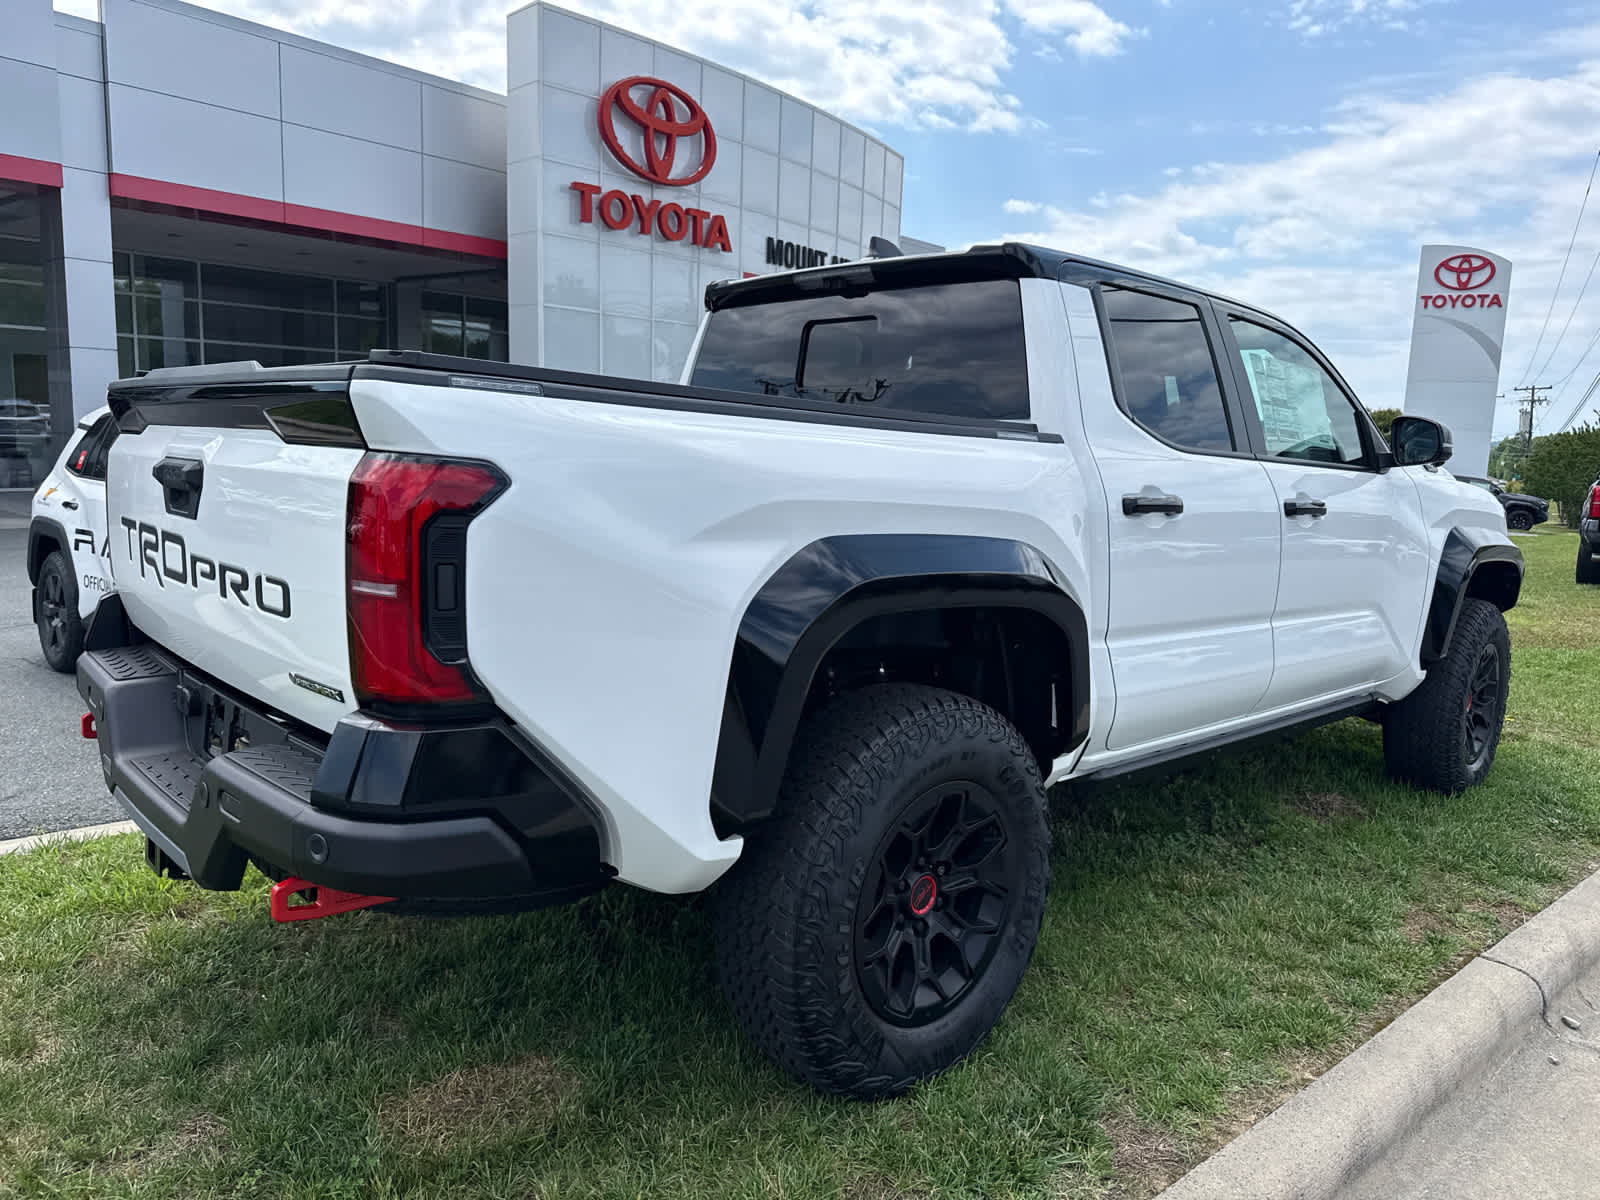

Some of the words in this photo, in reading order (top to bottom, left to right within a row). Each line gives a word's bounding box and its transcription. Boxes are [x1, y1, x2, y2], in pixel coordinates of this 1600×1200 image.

[569, 181, 732, 253] TOYOTA
[766, 236, 828, 270] MOUNT
[1420, 293, 1503, 310] TOYOTA
